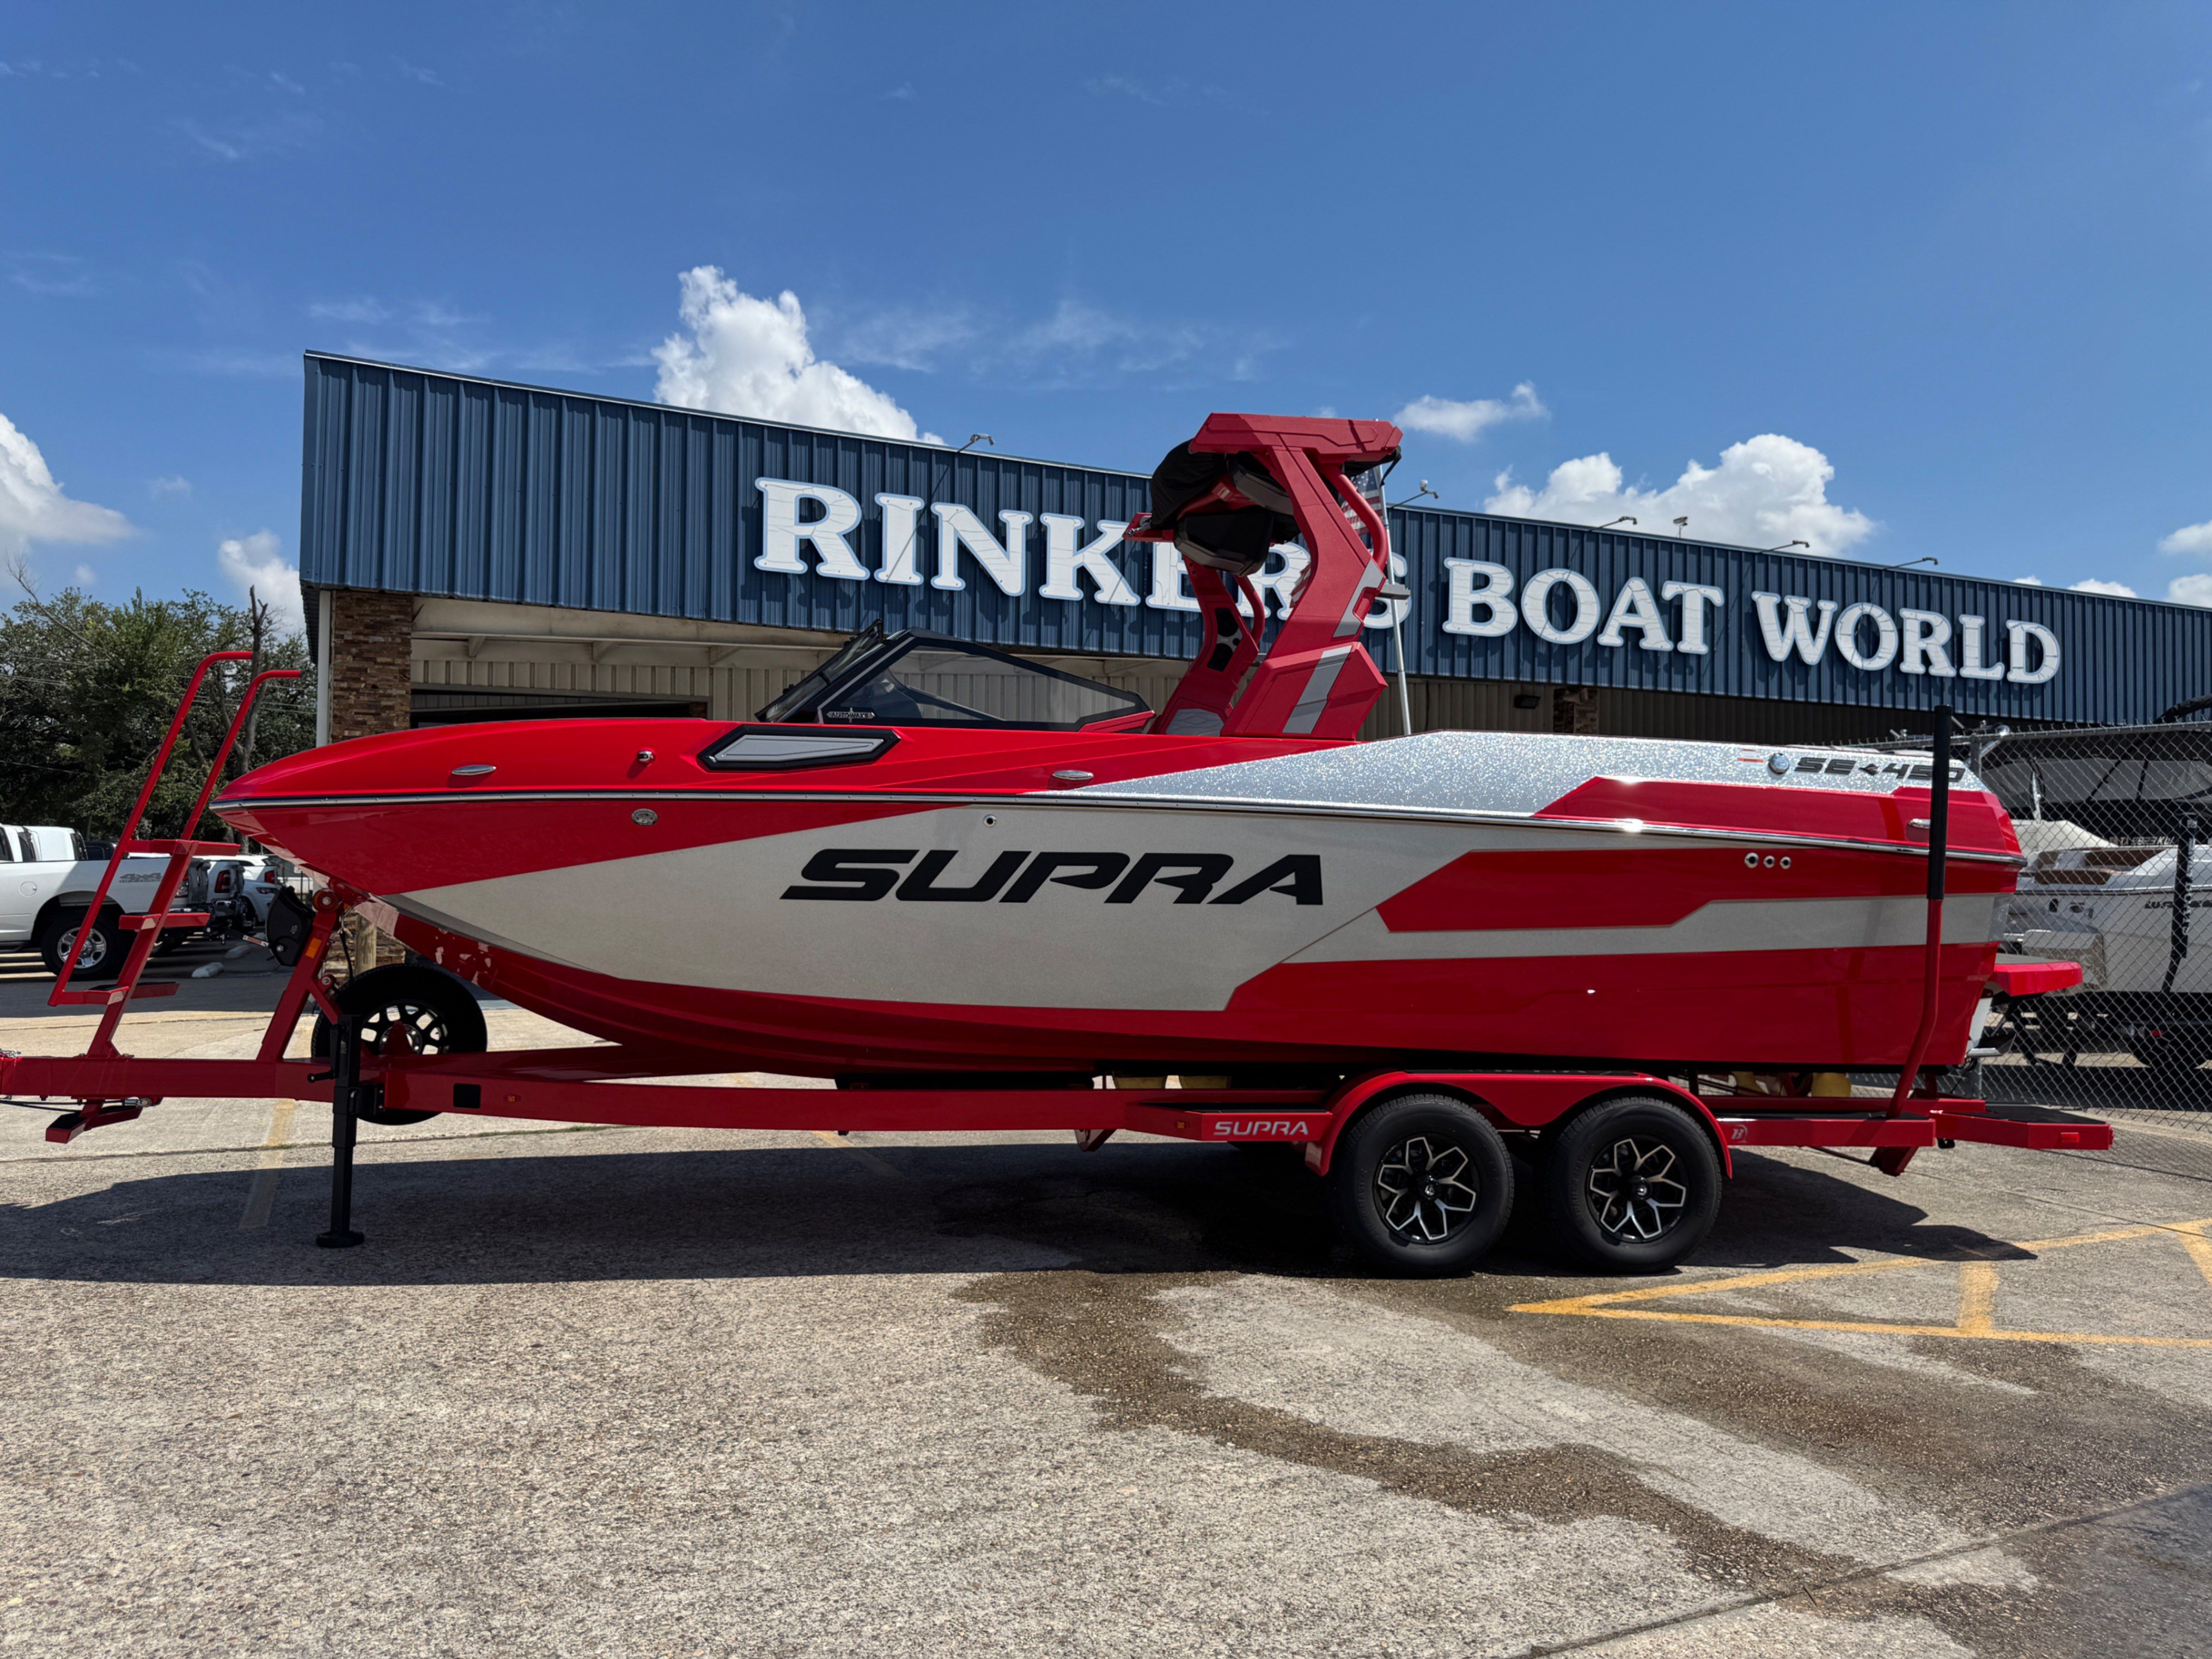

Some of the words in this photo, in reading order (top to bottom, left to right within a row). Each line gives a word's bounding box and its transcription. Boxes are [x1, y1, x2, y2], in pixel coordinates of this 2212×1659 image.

[1442, 557, 1724, 654] BOAT
[1752, 591, 2060, 684] WORLD
[1794, 757, 1856, 775] SE
[779, 848, 1324, 905] SUPRA
[1214, 1121, 1308, 1136] SUPRA
